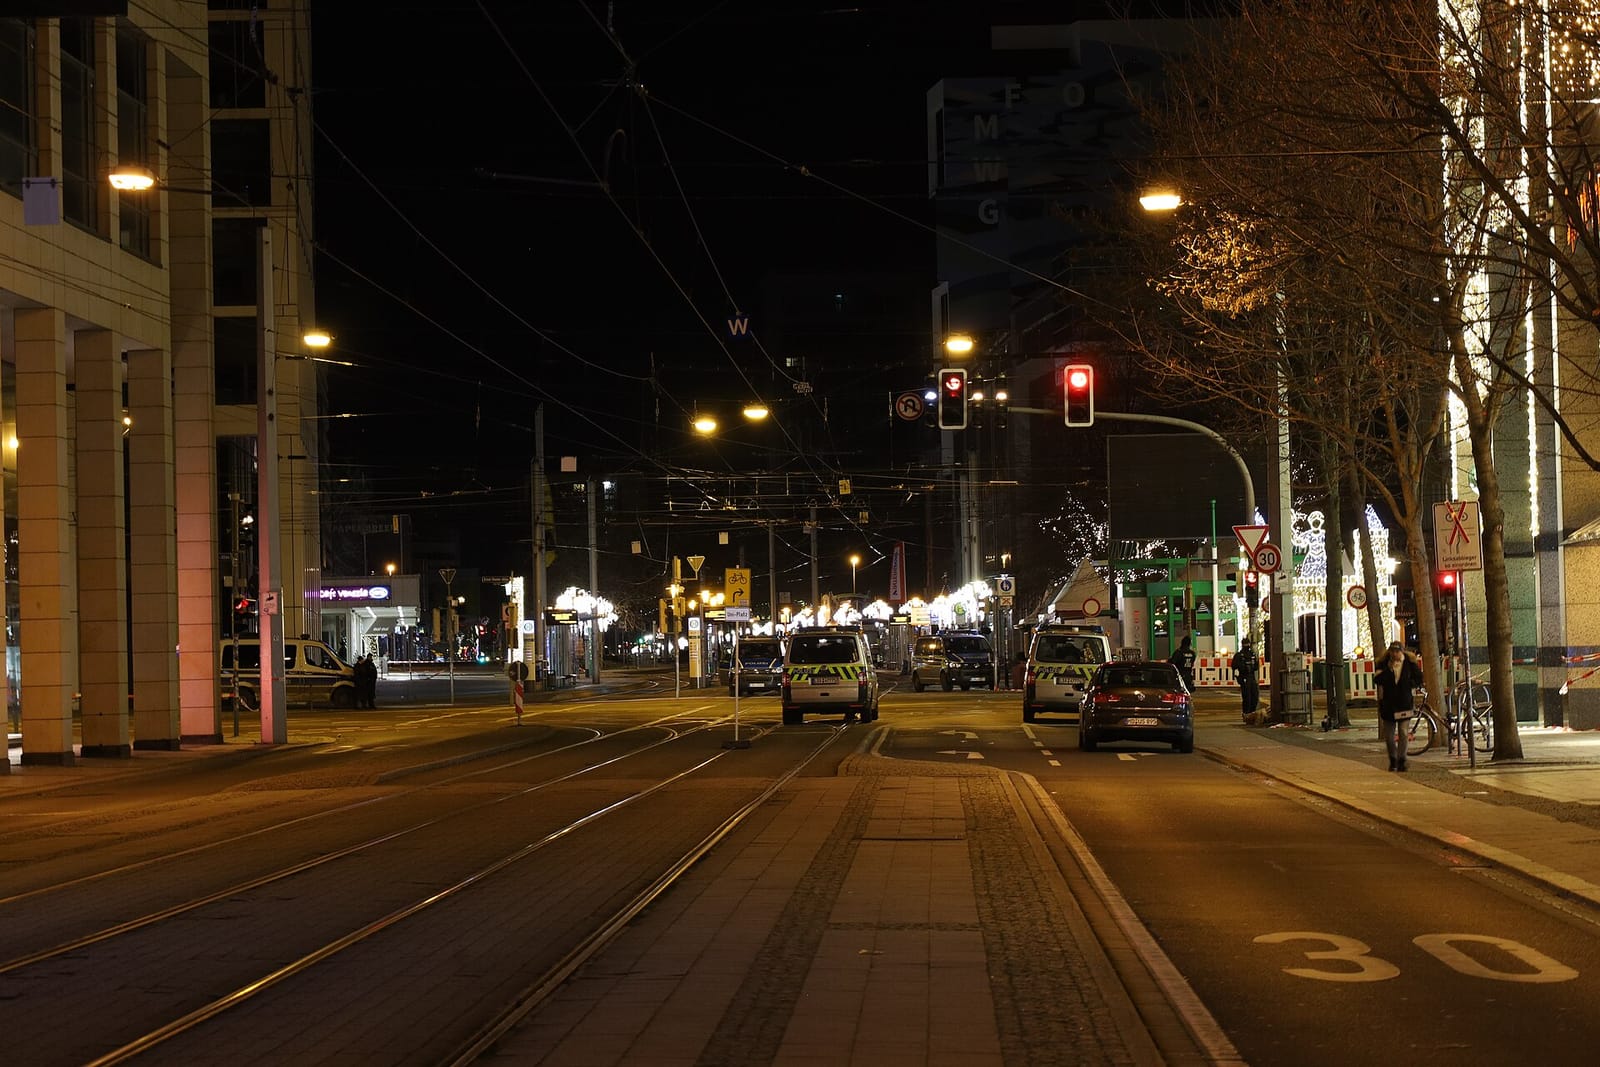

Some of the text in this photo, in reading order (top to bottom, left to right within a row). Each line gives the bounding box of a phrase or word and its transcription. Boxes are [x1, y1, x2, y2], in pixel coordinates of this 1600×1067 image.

[727, 318, 749, 336] W
[1259, 552, 1275, 567] 30
[1252, 931, 1580, 983] 30
